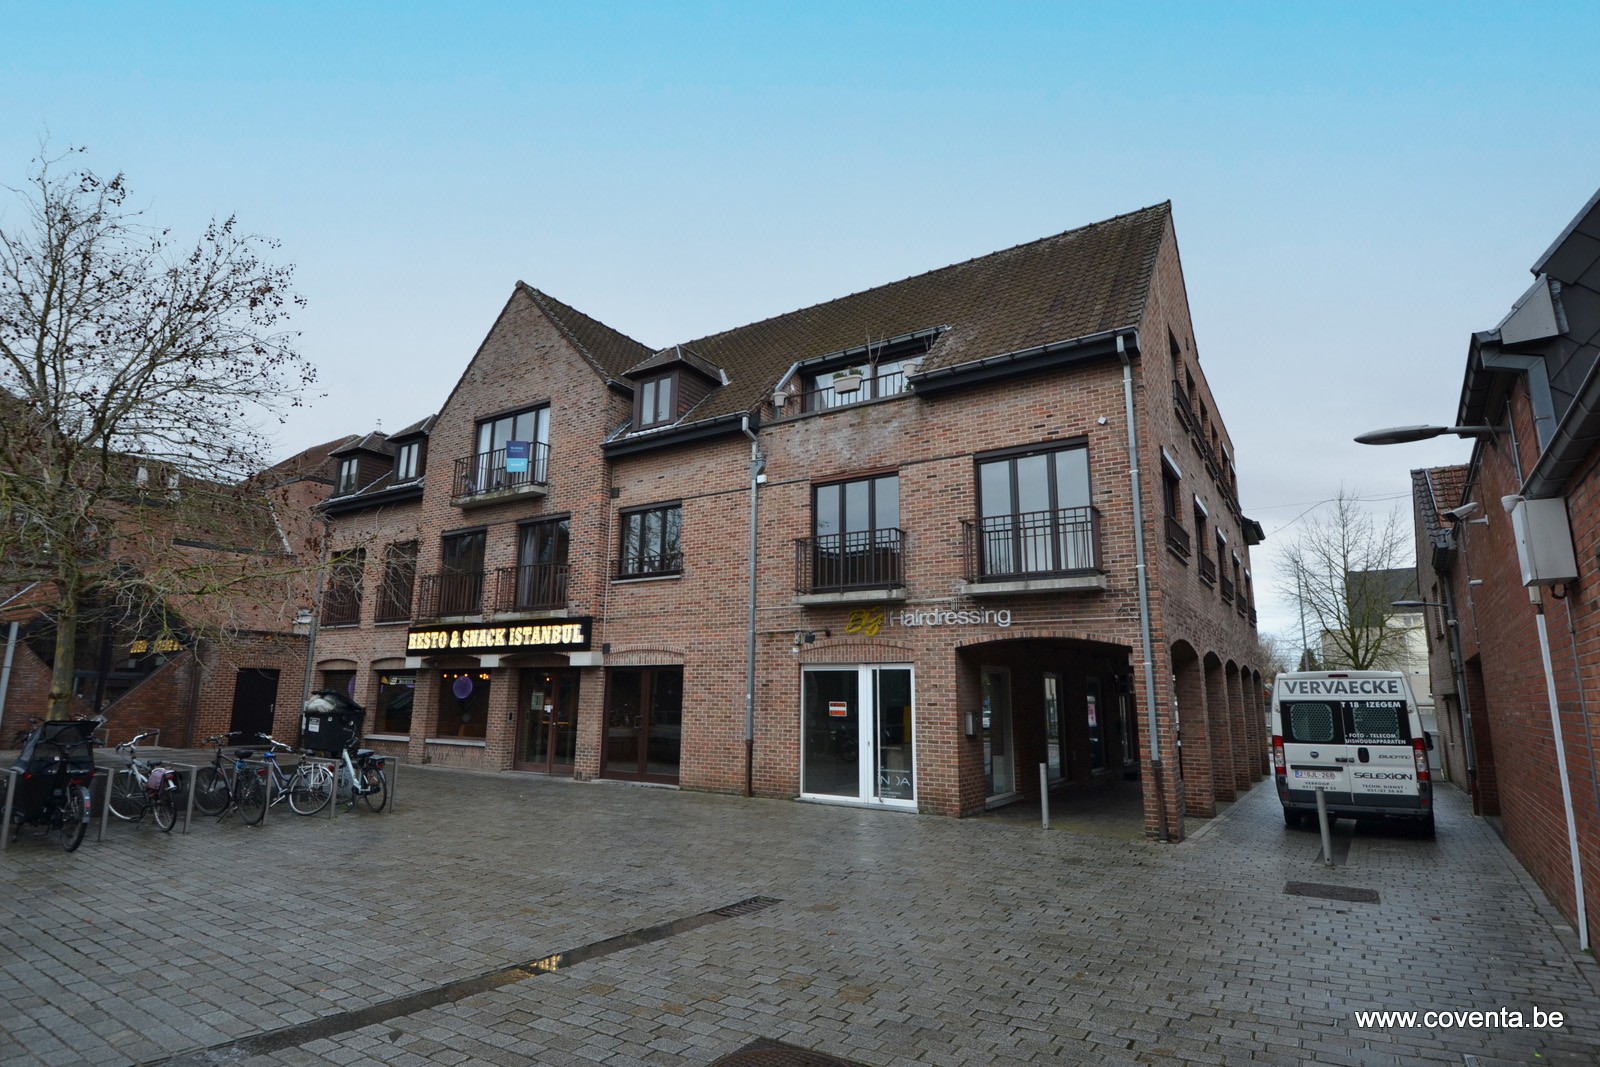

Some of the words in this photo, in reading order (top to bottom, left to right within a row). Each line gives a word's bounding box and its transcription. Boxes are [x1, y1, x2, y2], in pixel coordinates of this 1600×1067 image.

[890, 606, 1011, 628] Hairdressing
[408, 631, 448, 650] RESTO
[449, 630, 461, 648] &
[462, 628, 507, 648] SNACK
[508, 624, 584, 646] ISTANBUL
[1284, 680, 1399, 695] VERVAECKE
